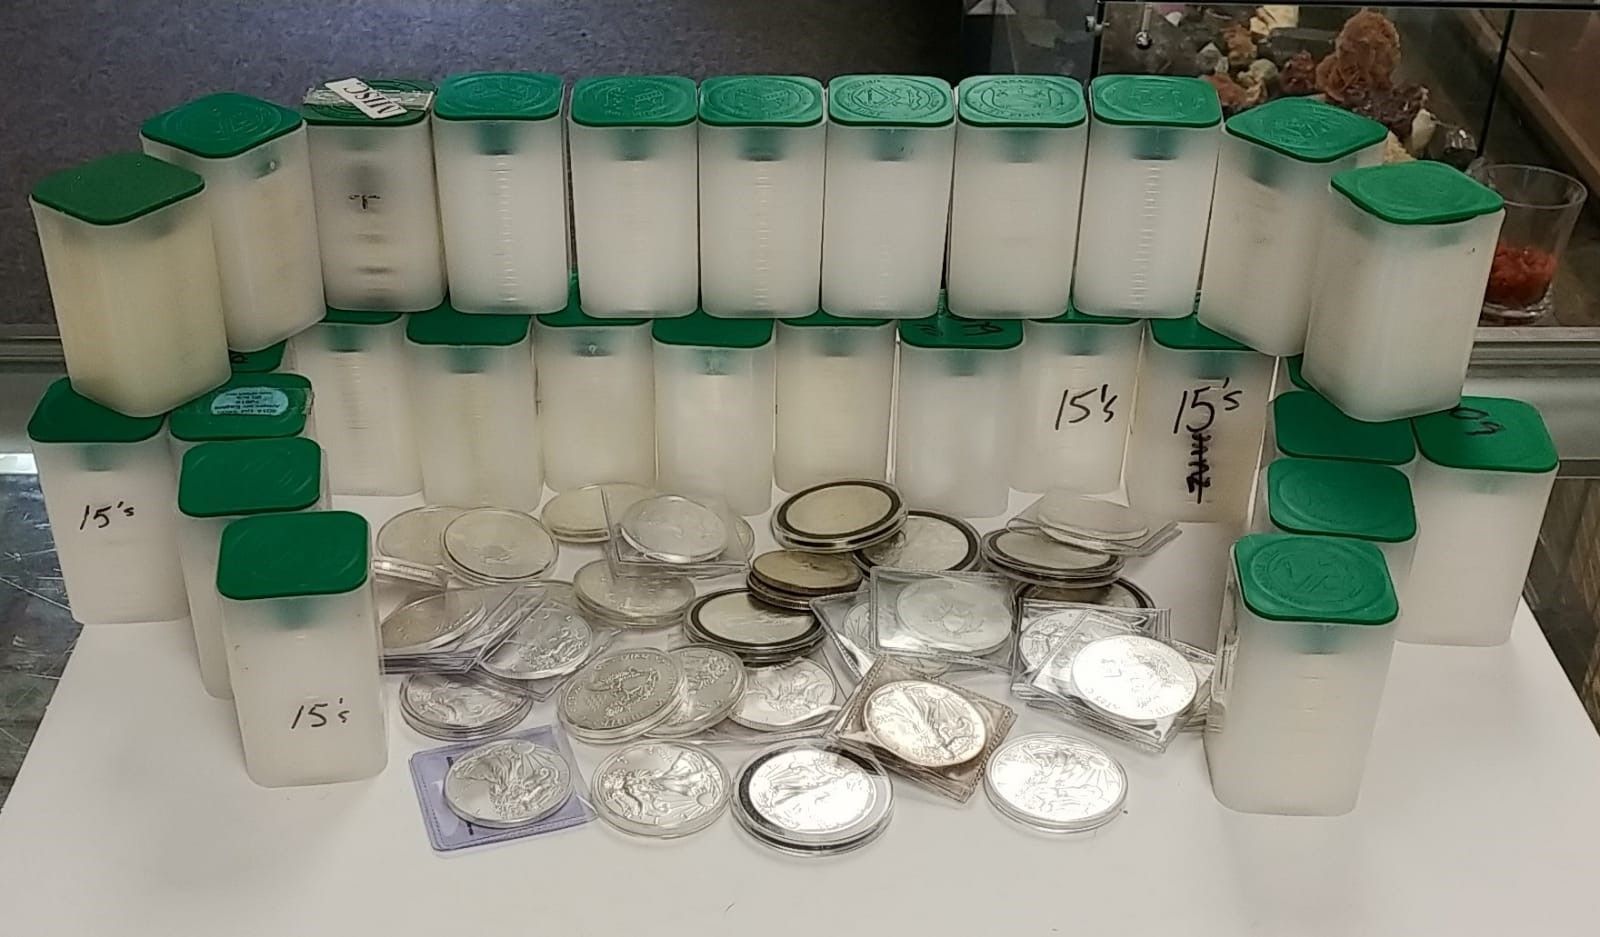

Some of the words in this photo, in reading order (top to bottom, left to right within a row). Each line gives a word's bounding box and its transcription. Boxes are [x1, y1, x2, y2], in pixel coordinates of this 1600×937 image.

[1055, 384, 1118, 430] 15's
[1173, 377, 1242, 433] 15's
[80, 501, 135, 530] 15's
[291, 697, 350, 729] 15's
